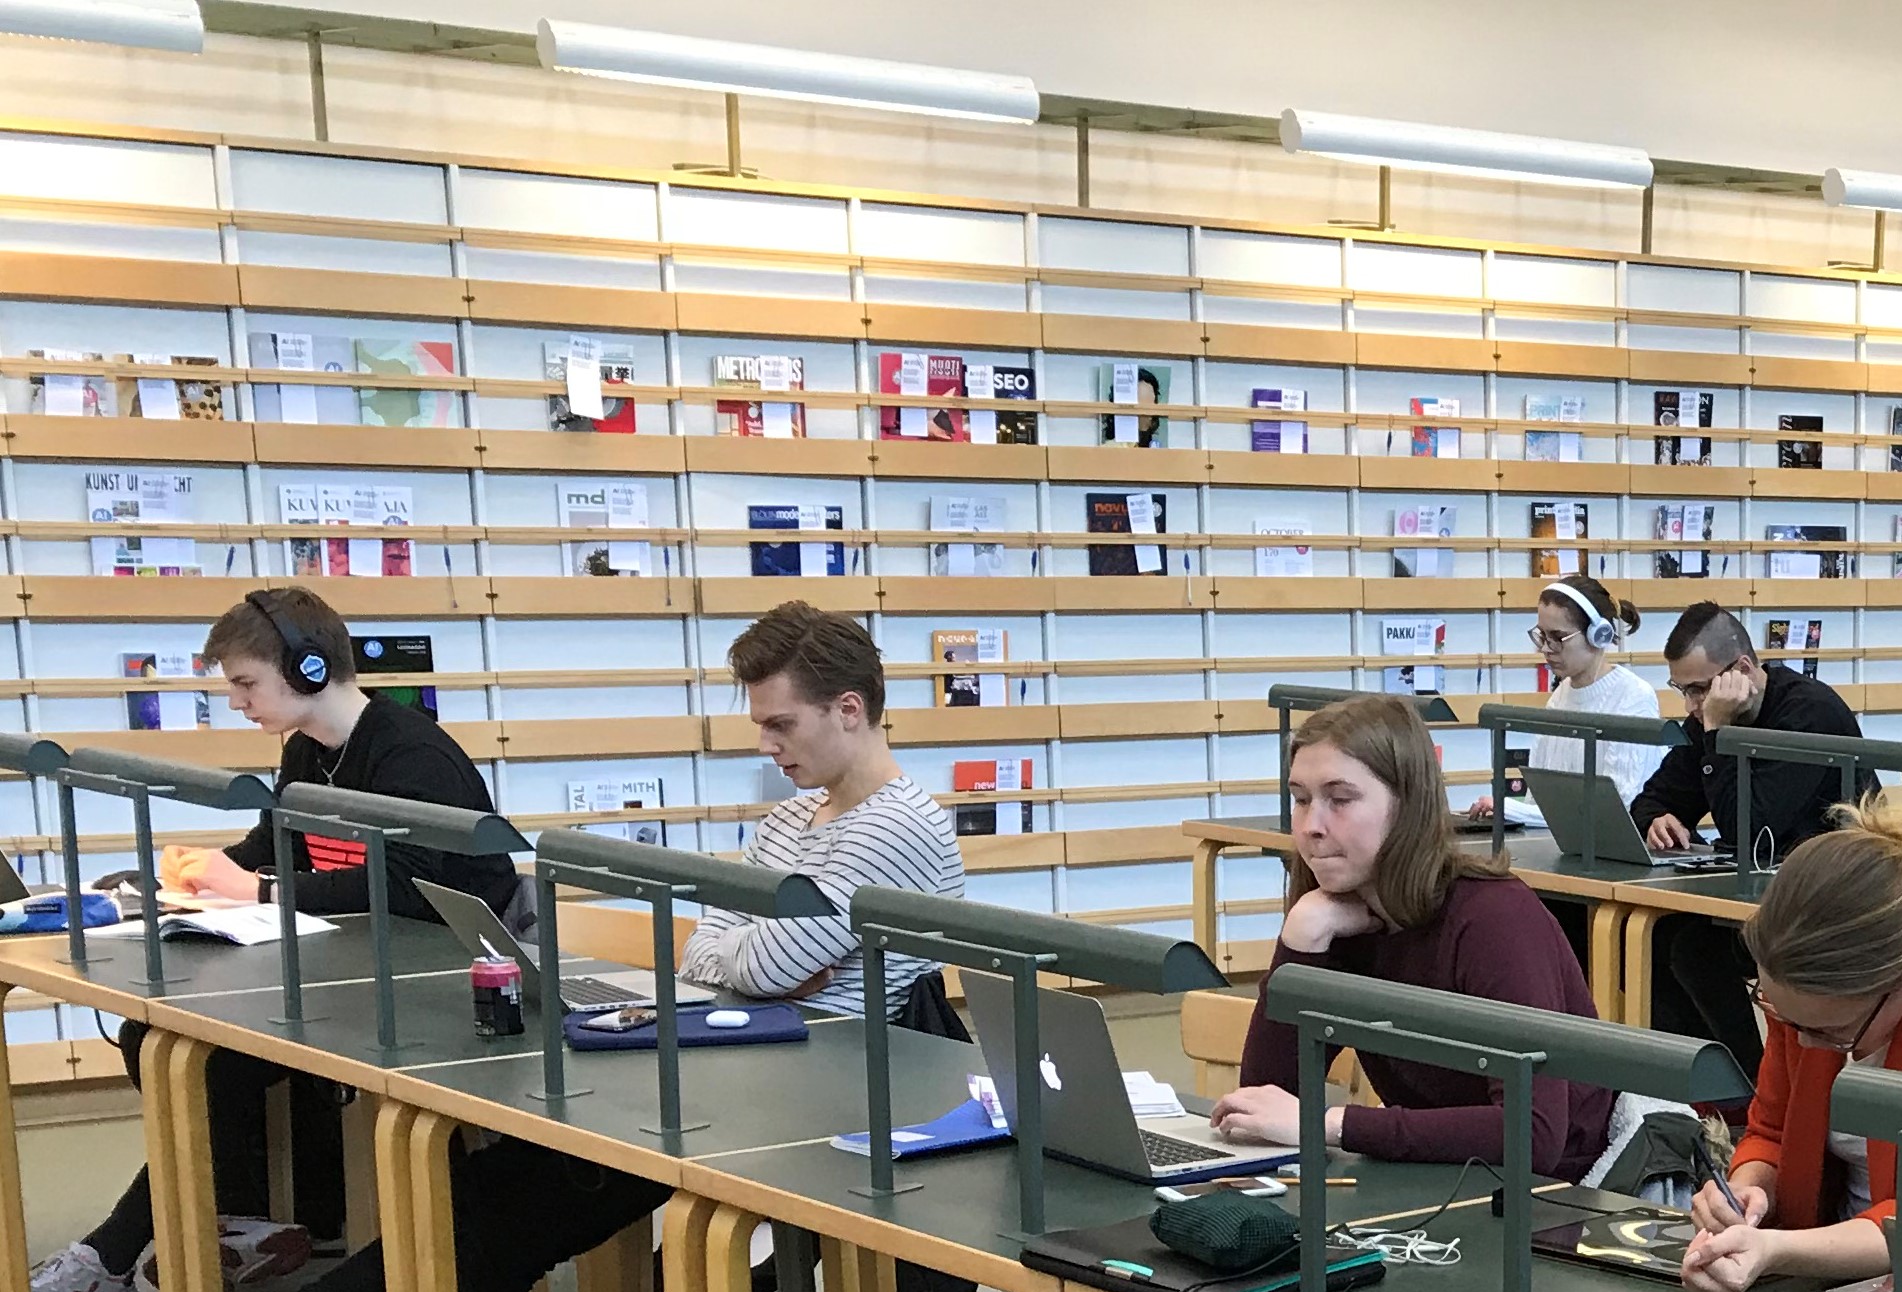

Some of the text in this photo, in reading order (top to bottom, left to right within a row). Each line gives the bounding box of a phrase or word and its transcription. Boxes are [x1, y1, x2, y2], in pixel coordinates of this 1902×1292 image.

[717, 356, 802, 382] METRIS
[85, 473, 120, 490] KUNST
[567, 489, 605, 504] md
[974, 781, 995, 790] new
